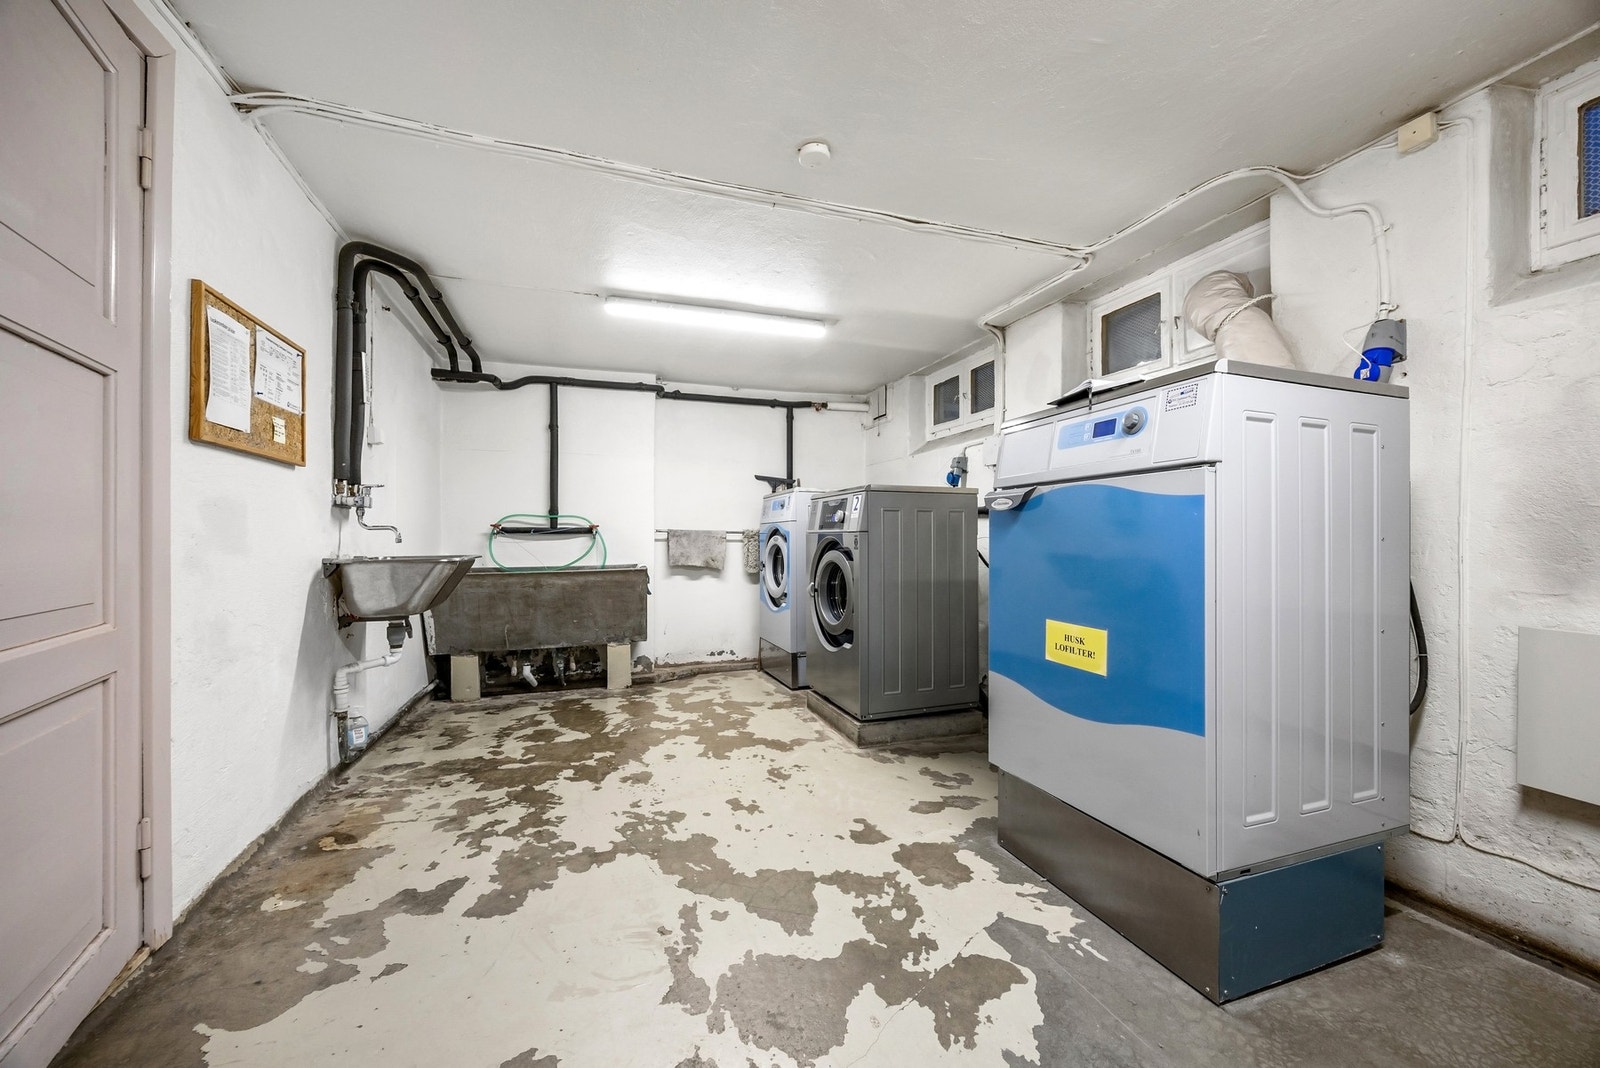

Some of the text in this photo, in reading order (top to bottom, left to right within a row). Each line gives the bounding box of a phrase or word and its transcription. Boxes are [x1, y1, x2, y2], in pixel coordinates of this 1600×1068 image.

[853, 496, 860, 511] 2
[1064, 634, 1085, 646] HUSK
[1055, 643, 1096, 659] LOFILTER!
